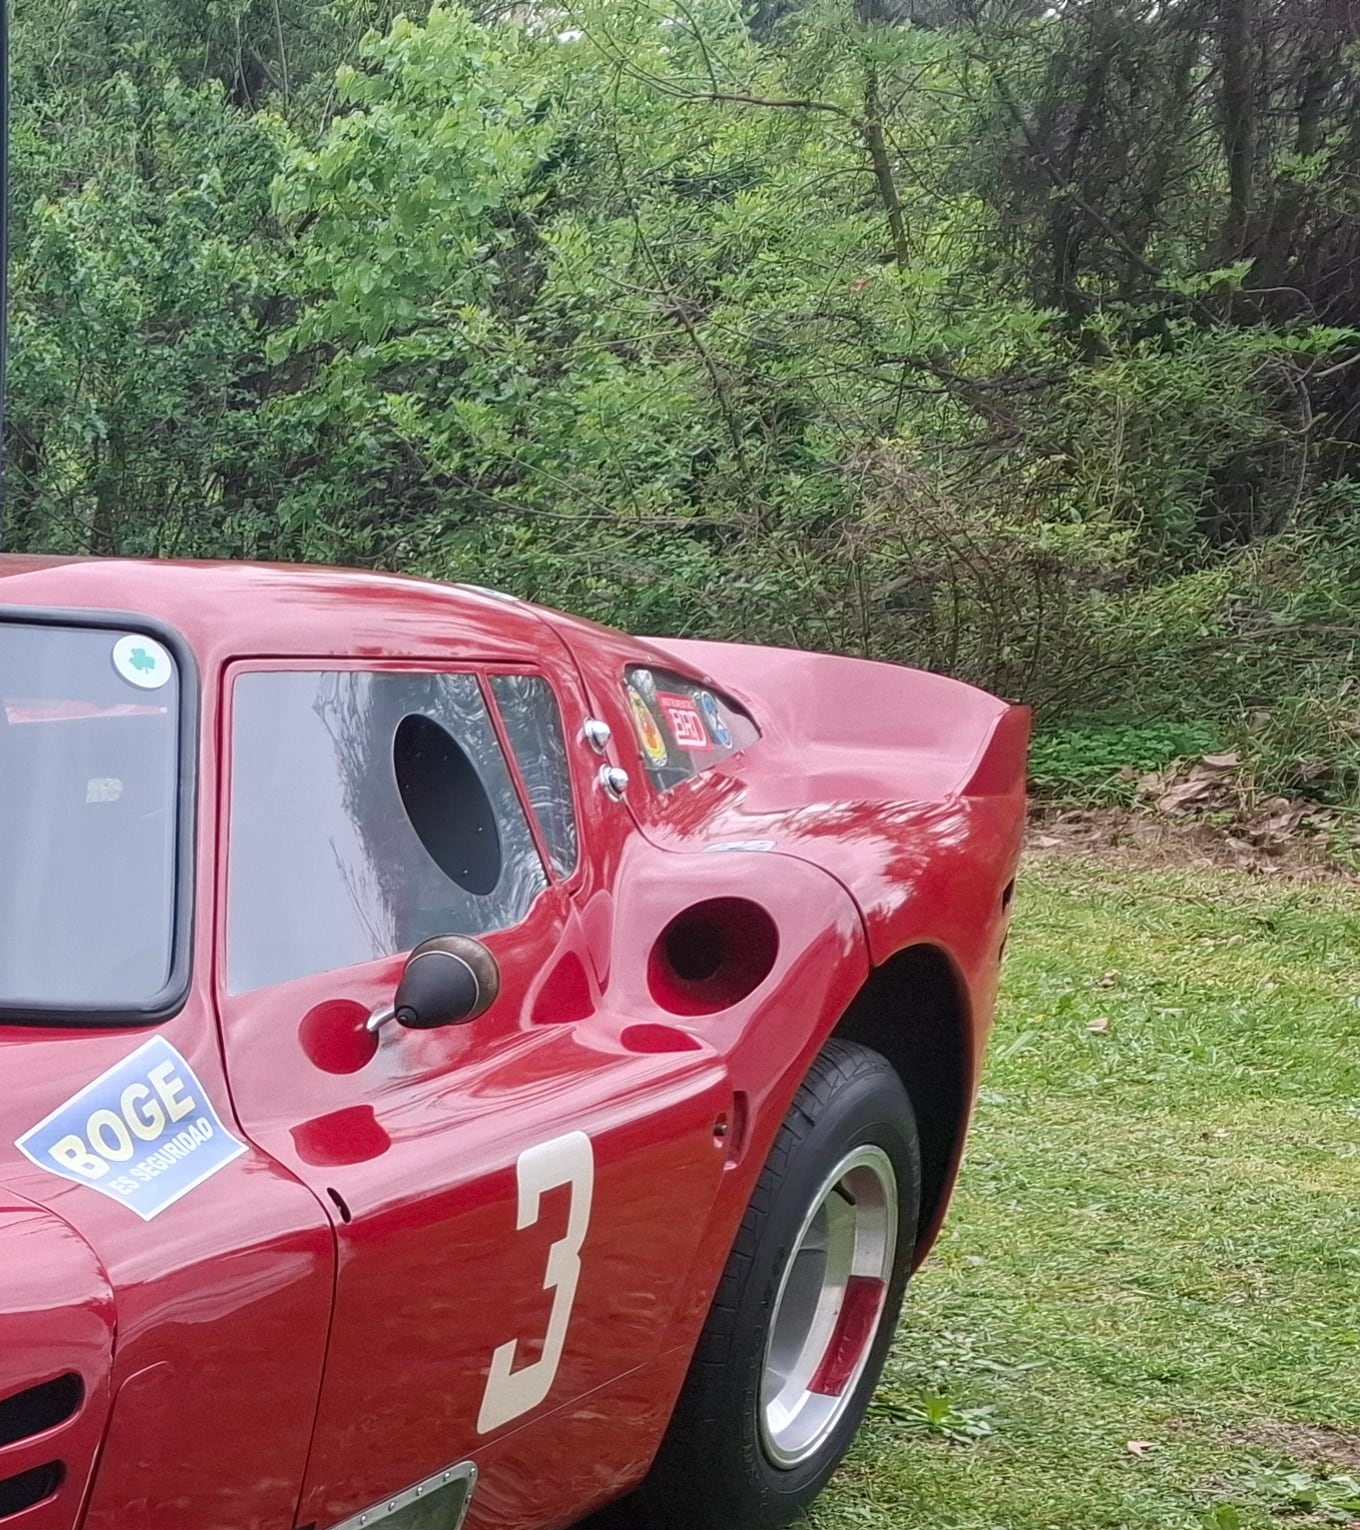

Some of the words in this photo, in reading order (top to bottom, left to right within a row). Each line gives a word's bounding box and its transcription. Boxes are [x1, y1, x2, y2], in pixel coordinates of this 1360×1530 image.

[47, 1059, 196, 1180] BOGE
[108, 1175, 140, 1195] ES
[129, 1116, 214, 1182] SEGURIDAD
[476, 1129, 595, 1435] 3
